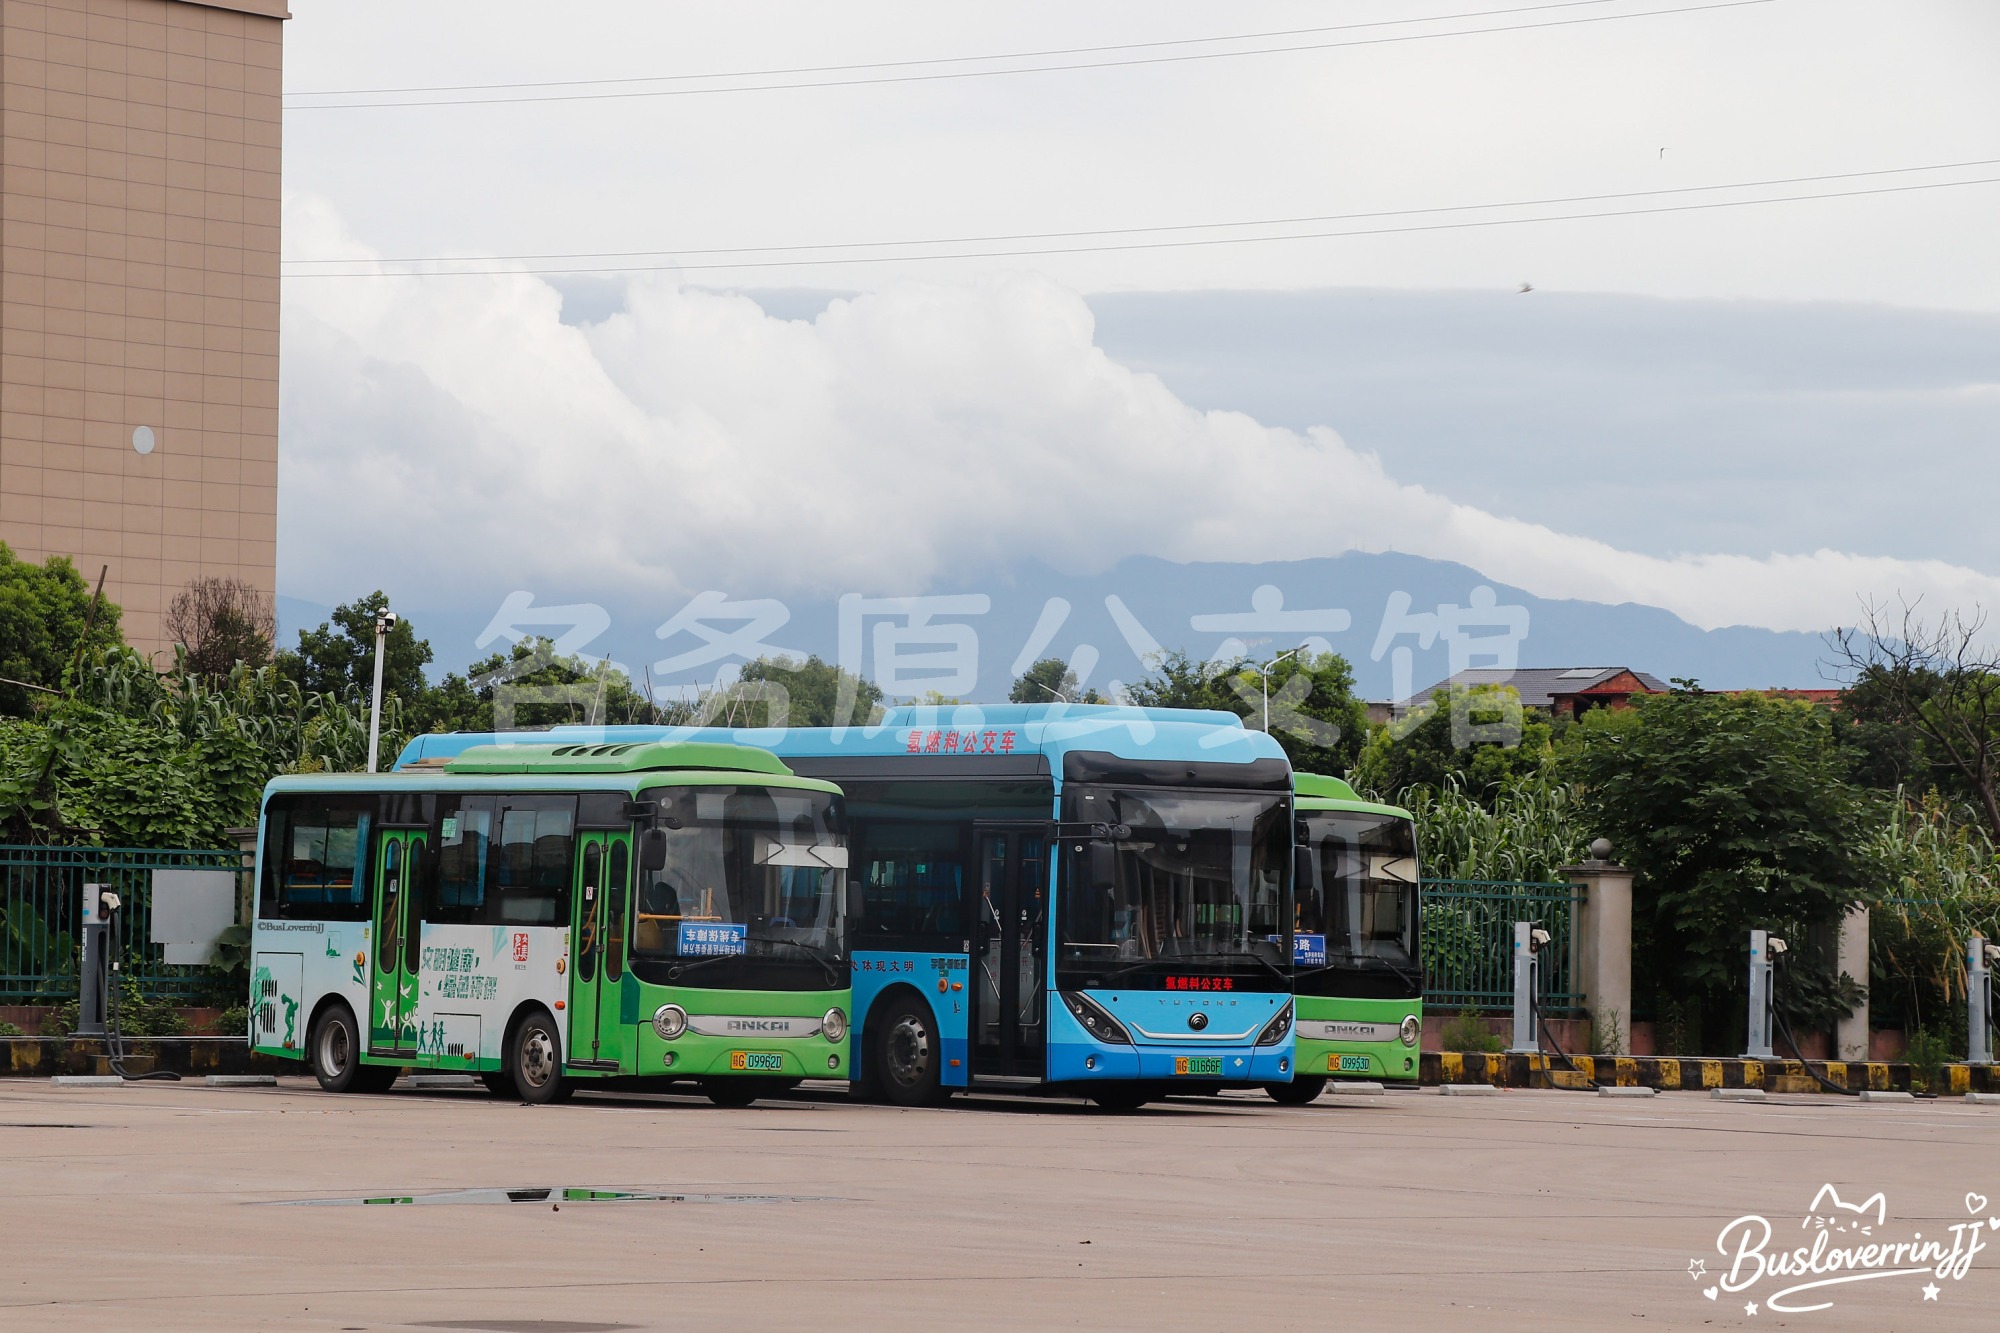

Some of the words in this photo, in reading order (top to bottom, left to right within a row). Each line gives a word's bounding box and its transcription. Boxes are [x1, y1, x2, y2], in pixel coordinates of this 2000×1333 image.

[906, 729, 1017, 754] 氢燃料公交车
[686, 928, 740, 943] 专线保障车
[1166, 976, 1233, 990] 氢燃料公交车
[727, 1020, 790, 1031] ANKAI
[1324, 1025, 1375, 1036] ANKAI
